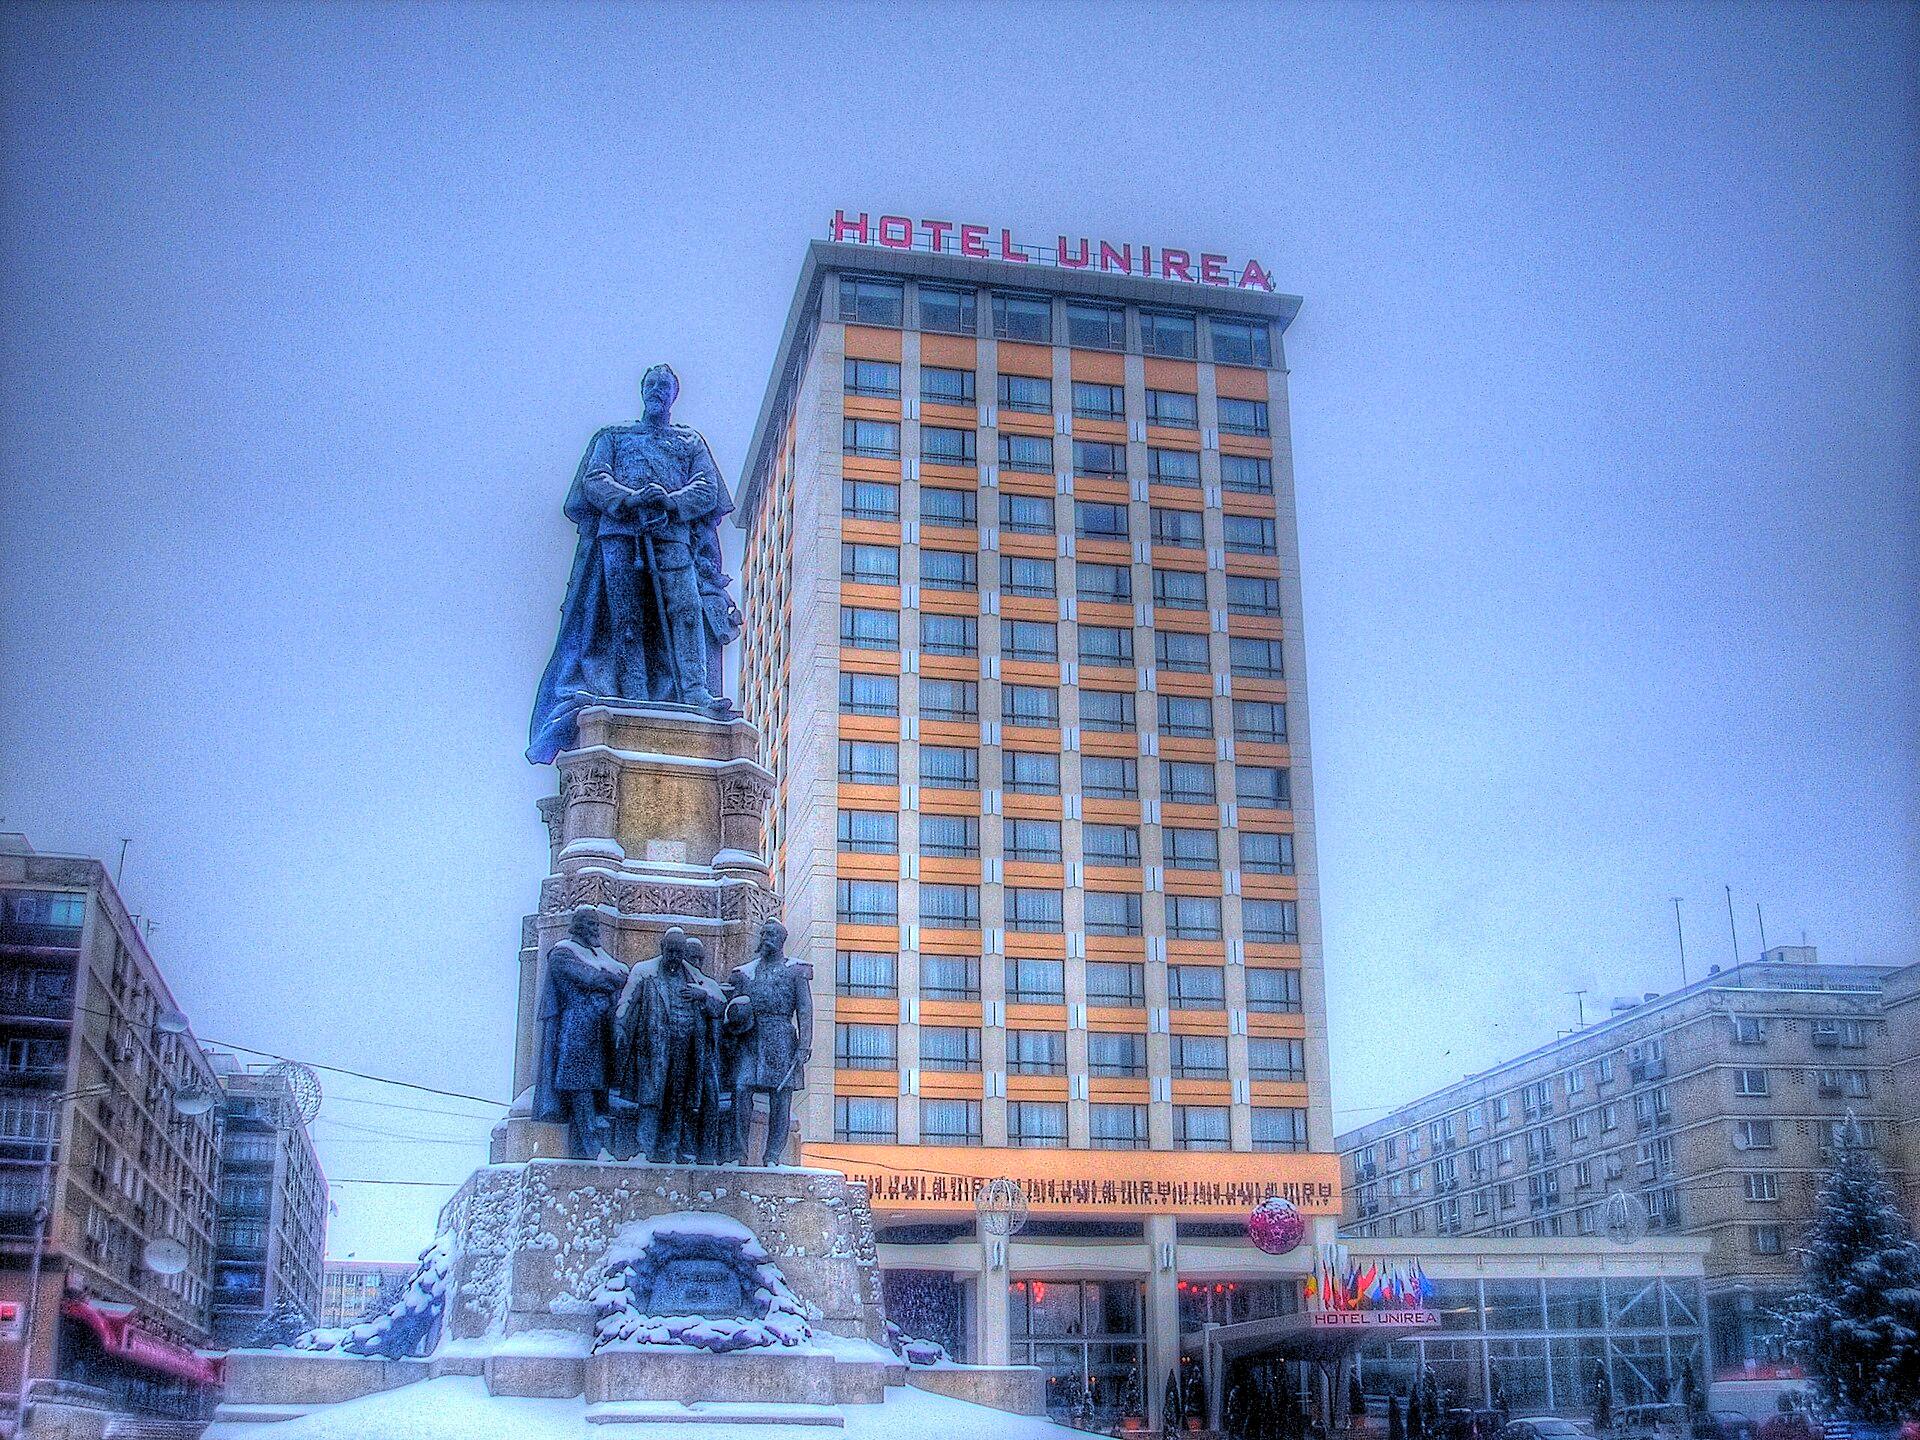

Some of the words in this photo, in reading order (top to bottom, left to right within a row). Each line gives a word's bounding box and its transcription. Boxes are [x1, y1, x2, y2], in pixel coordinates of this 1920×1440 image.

[834, 209, 1029, 263] HOTEL
[1058, 235, 1271, 291] UNIREA
[1315, 1314, 1370, 1324] HOTEL
[1378, 1313, 1437, 1323] UNIREA
